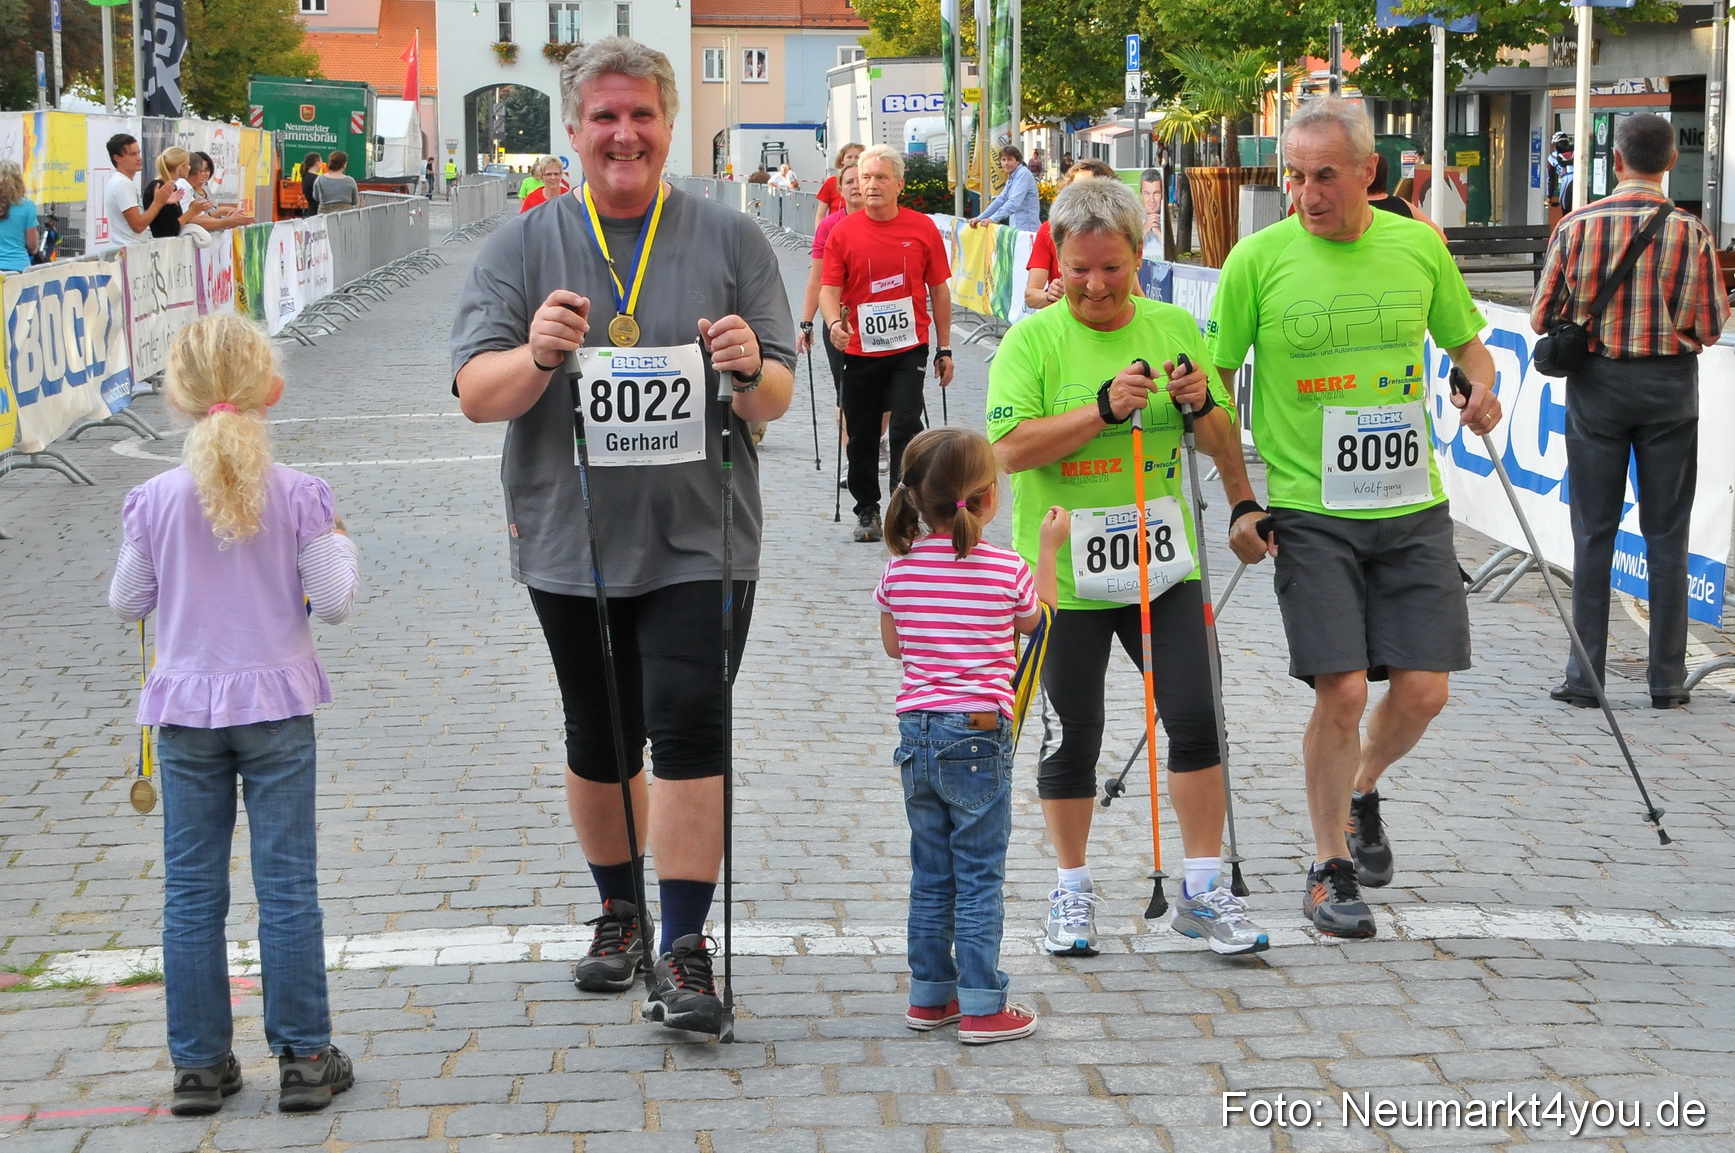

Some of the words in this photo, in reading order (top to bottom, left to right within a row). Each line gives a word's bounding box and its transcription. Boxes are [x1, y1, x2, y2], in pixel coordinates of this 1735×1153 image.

[1129, 39, 1137, 66] P
[882, 92, 968, 112] BOC
[283, 131, 337, 143] ammsbräu
[285, 123, 330, 133] Neumarkter
[865, 312, 909, 335] 8045
[871, 334, 907, 346] Johannes
[611, 356, 668, 369] BOCK
[1296, 374, 1357, 393] MERZ
[590, 377, 691, 423] 8022
[1358, 411, 1403, 426] BOCK
[606, 430, 679, 452] Gerhard
[1337, 429, 1419, 472] 8096
[1060, 458, 1123, 477] MERZ
[1352, 481, 1402, 497] Wolfgang
